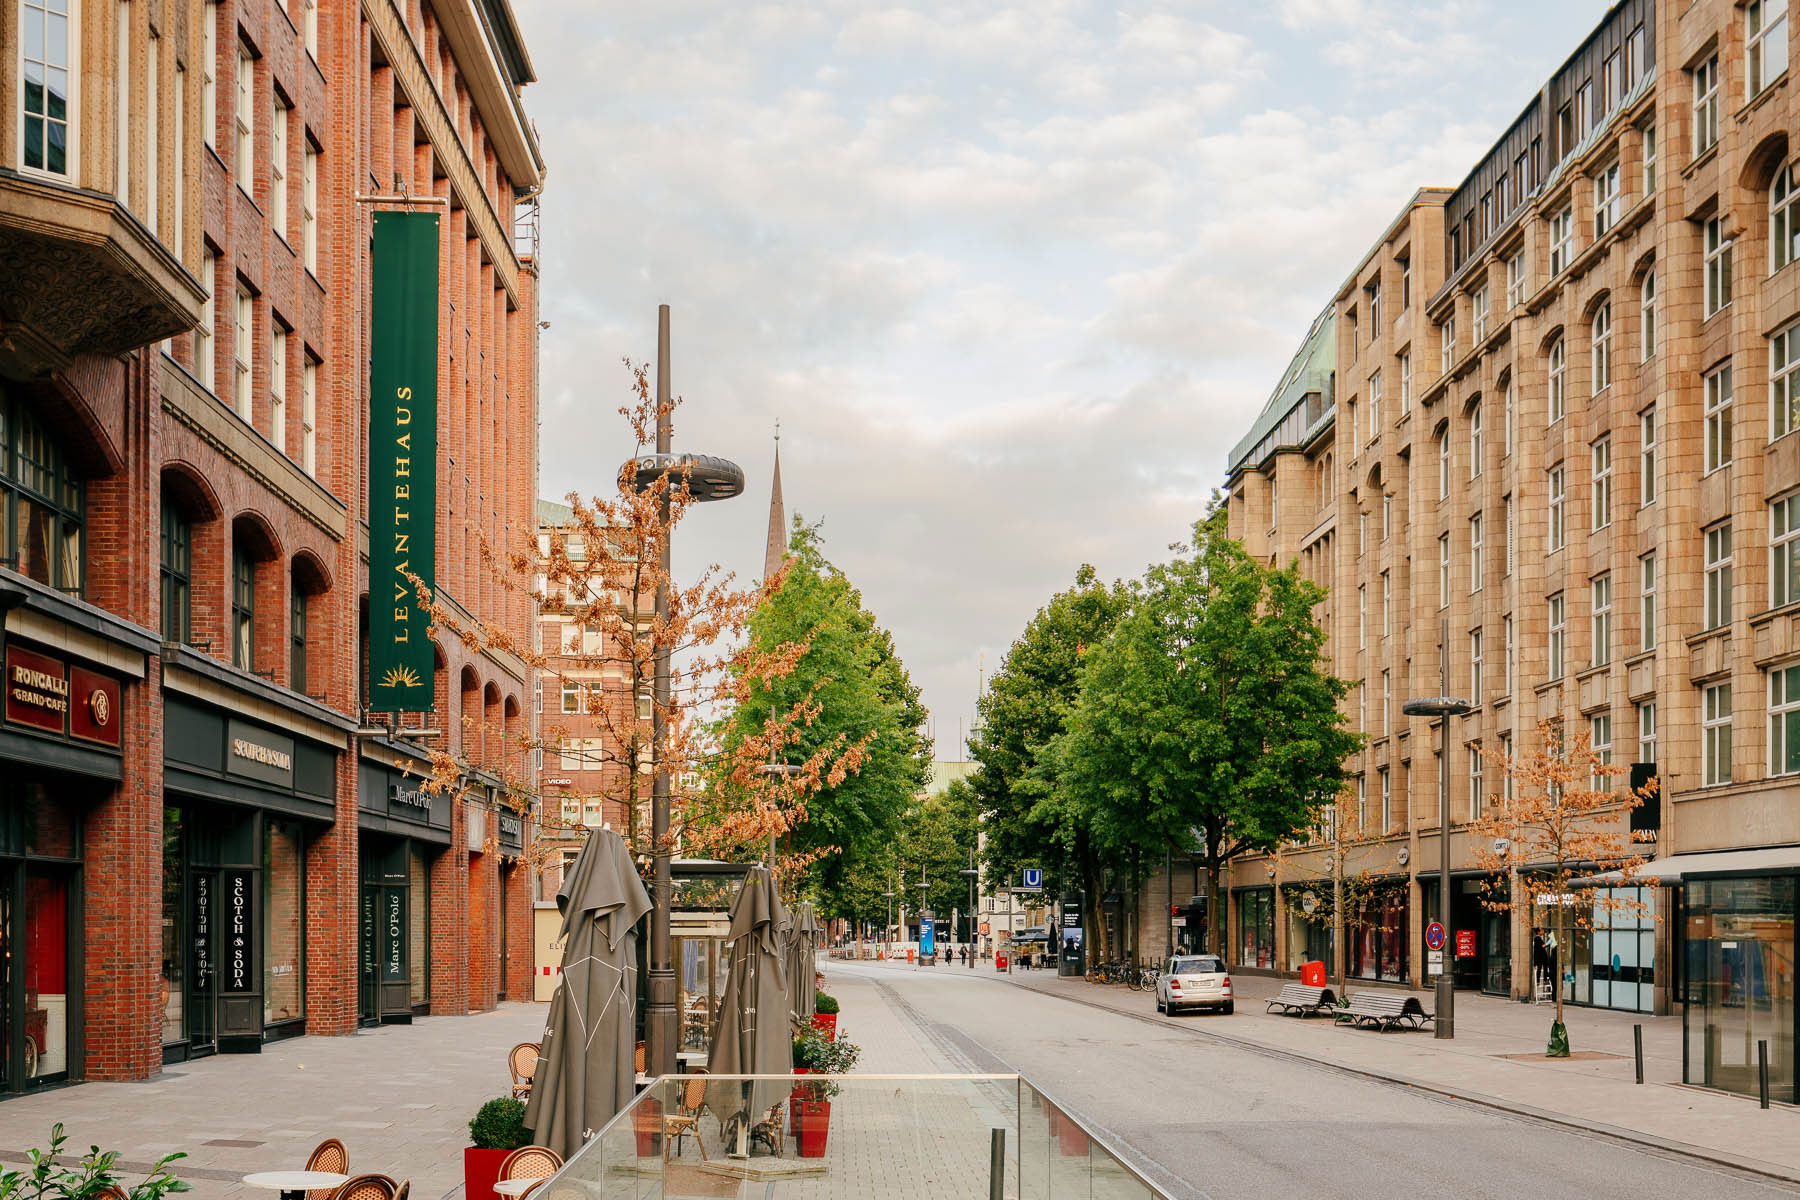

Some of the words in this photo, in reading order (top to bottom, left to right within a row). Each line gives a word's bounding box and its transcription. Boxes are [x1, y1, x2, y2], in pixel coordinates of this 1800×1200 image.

[395, 386, 412, 644] LEVANTEHAUS
[15, 665, 68, 696] RONCALLI
[15, 688, 44, 706] GRAND
[233, 877, 244, 934] SCOTCH
[390, 895, 399, 937] O'Polo
[233, 937, 244, 946] &
[390, 940, 399, 974] Marc
[233, 949, 244, 988] SODA
